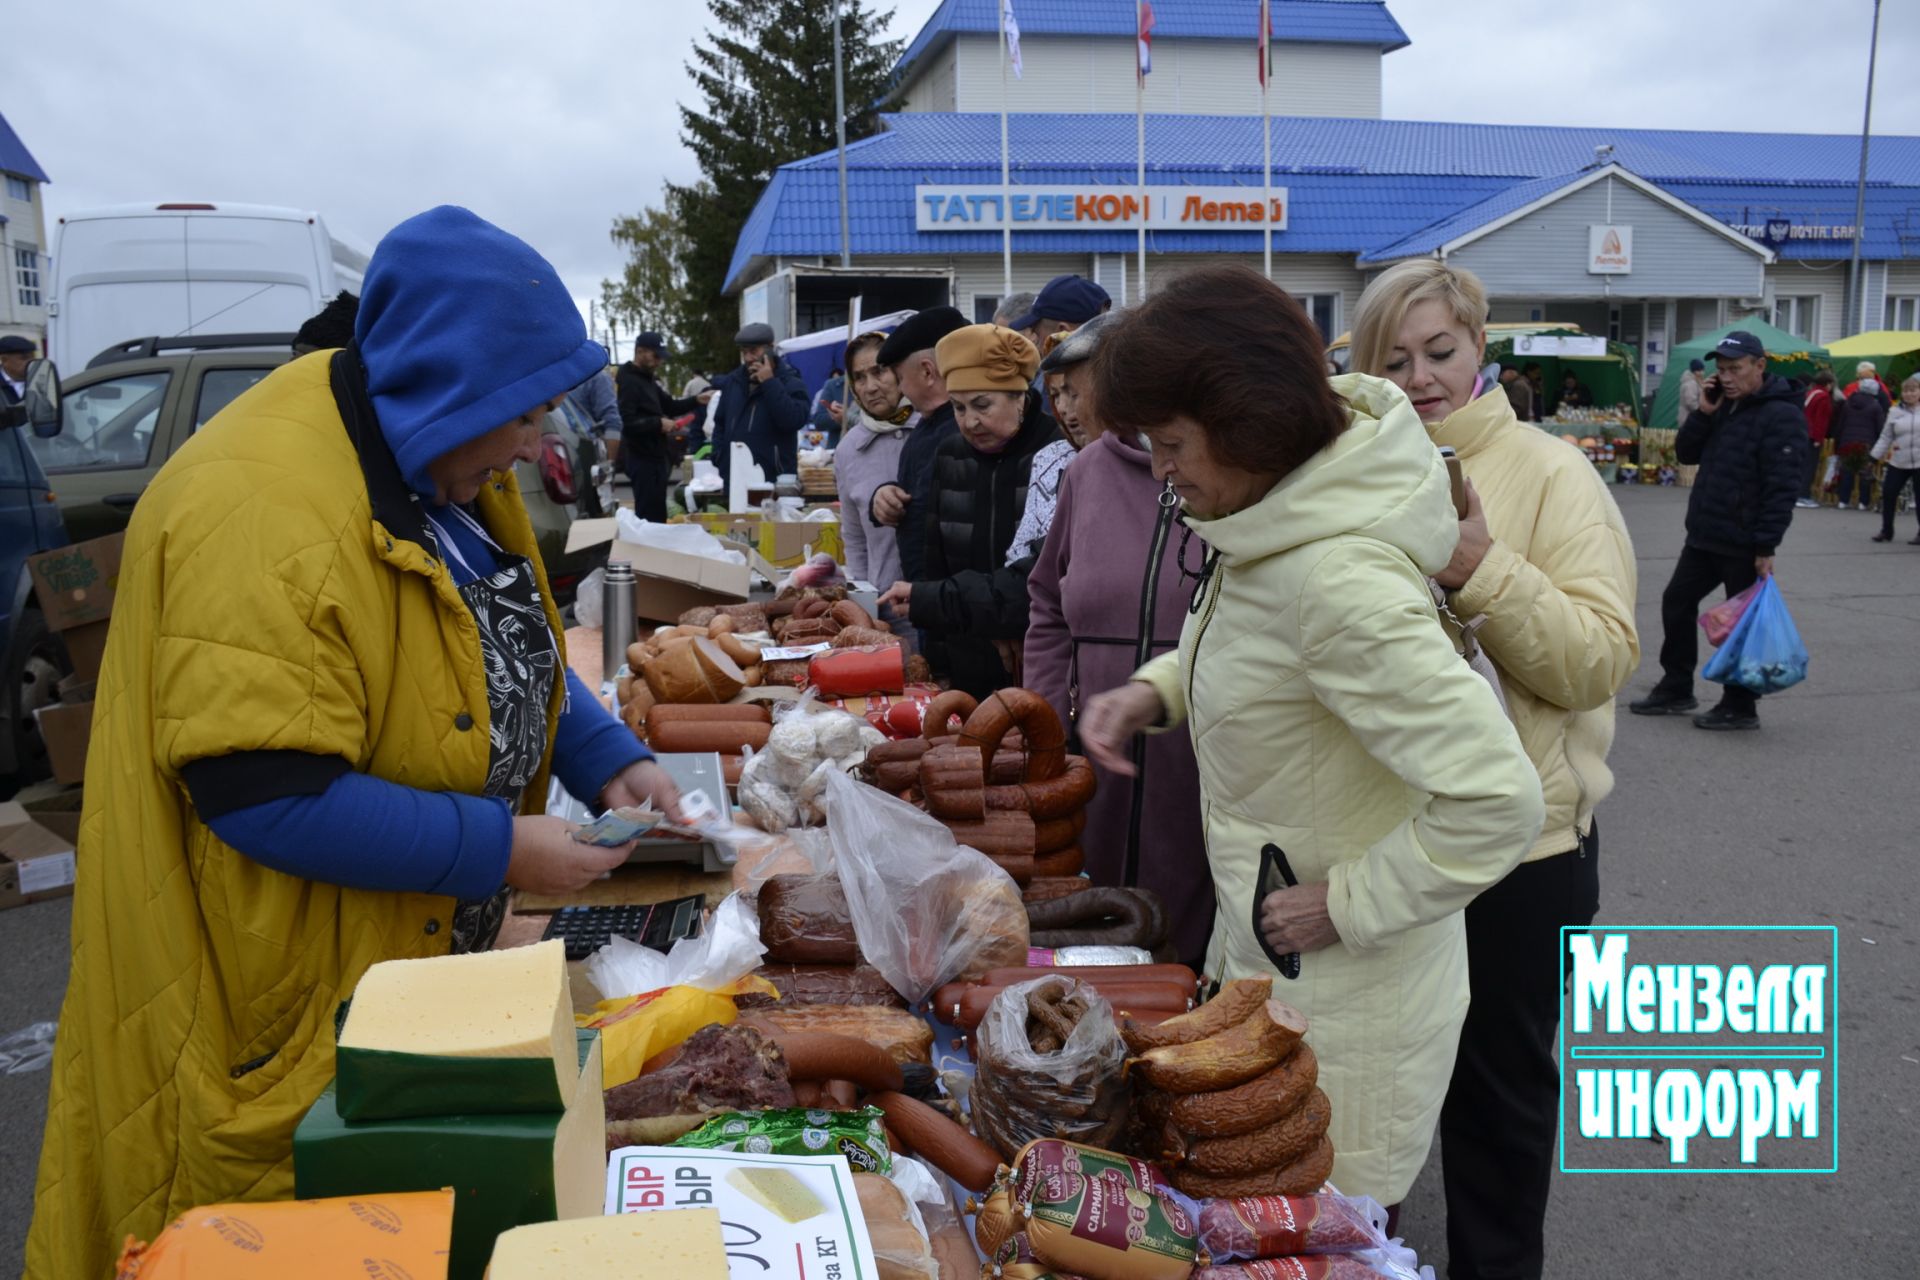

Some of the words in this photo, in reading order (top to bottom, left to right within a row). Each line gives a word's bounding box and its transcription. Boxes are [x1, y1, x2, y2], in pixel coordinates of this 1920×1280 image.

[923, 194, 1150, 222] ТАТТЕЛЕКОМ
[1181, 195, 1282, 222] Летай
[1789, 225, 1827, 239] ПОЧТА
[626, 1166, 664, 1213] ЫР
[675, 1166, 713, 1209] ЫР
[1088, 1175, 1102, 1233] САРМАНО
[815, 1235, 838, 1258] КГ
[825, 1262, 842, 1280] за
